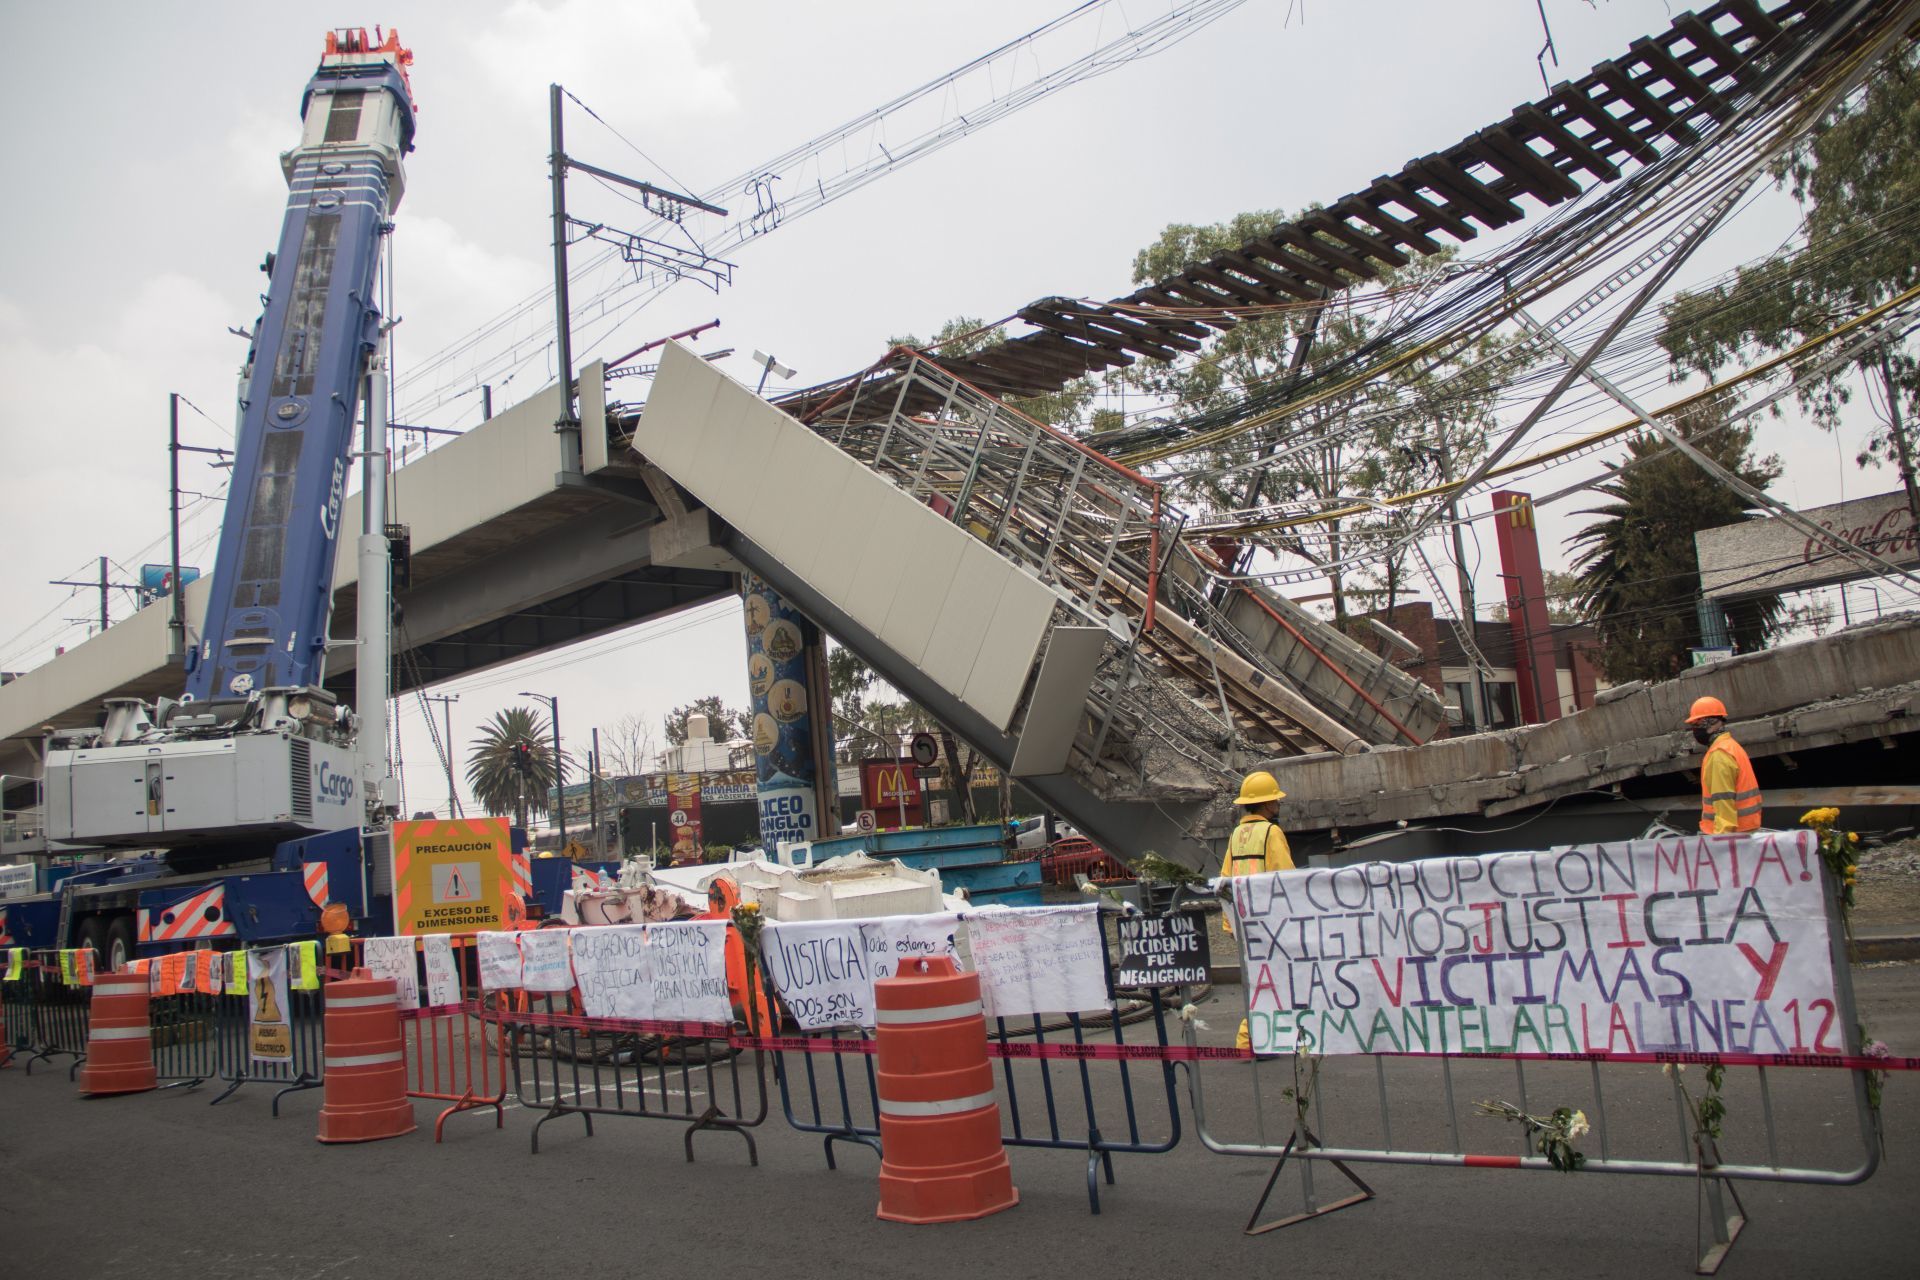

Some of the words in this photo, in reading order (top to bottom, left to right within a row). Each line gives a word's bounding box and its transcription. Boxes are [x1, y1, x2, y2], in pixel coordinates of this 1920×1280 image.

[320, 761, 353, 806] Cargo
[883, 790, 916, 798] McDoald's
[760, 813, 811, 831] ANGLO
[416, 842, 492, 854] PRECAUCIÓN
[1306, 843, 1637, 913] CORRUPCIÓN
[1654, 831, 1813, 892] MATA!
[424, 907, 472, 917] EXCESO
[475, 906, 491, 914] DE
[417, 915, 499, 929] DIMENSIONES
[1120, 920, 1140, 938] NO
[1141, 919, 1165, 938] FUE
[1170, 917, 1195, 934] UN
[896, 935, 936, 953] estamos
[1123, 934, 1198, 955] ACCIDENTE
[770, 928, 865, 993] JUSTICIA
[1146, 953, 1175, 967] FUE
[1120, 966, 1206, 985] NEGLIGENCIA
[1250, 963, 1282, 1010] A
[1288, 960, 1360, 1010] LAS
[1371, 945, 1693, 1008] VICTIMAS
[1736, 941, 1789, 1001] Y
[784, 998, 823, 1019] ODOS
[828, 993, 856, 1012] SON
[808, 1008, 864, 1026] CULPABLES
[996, 1043, 1031, 1056] PELIGRO
[1059, 1044, 1095, 1057] PELIGRO
[1125, 1045, 1163, 1058] PELIGRO
[1196, 1047, 1240, 1058] PELIGRO
[1656, 1052, 1720, 1064] PELIGRO
[1774, 1054, 1843, 1067] PELIGRO
